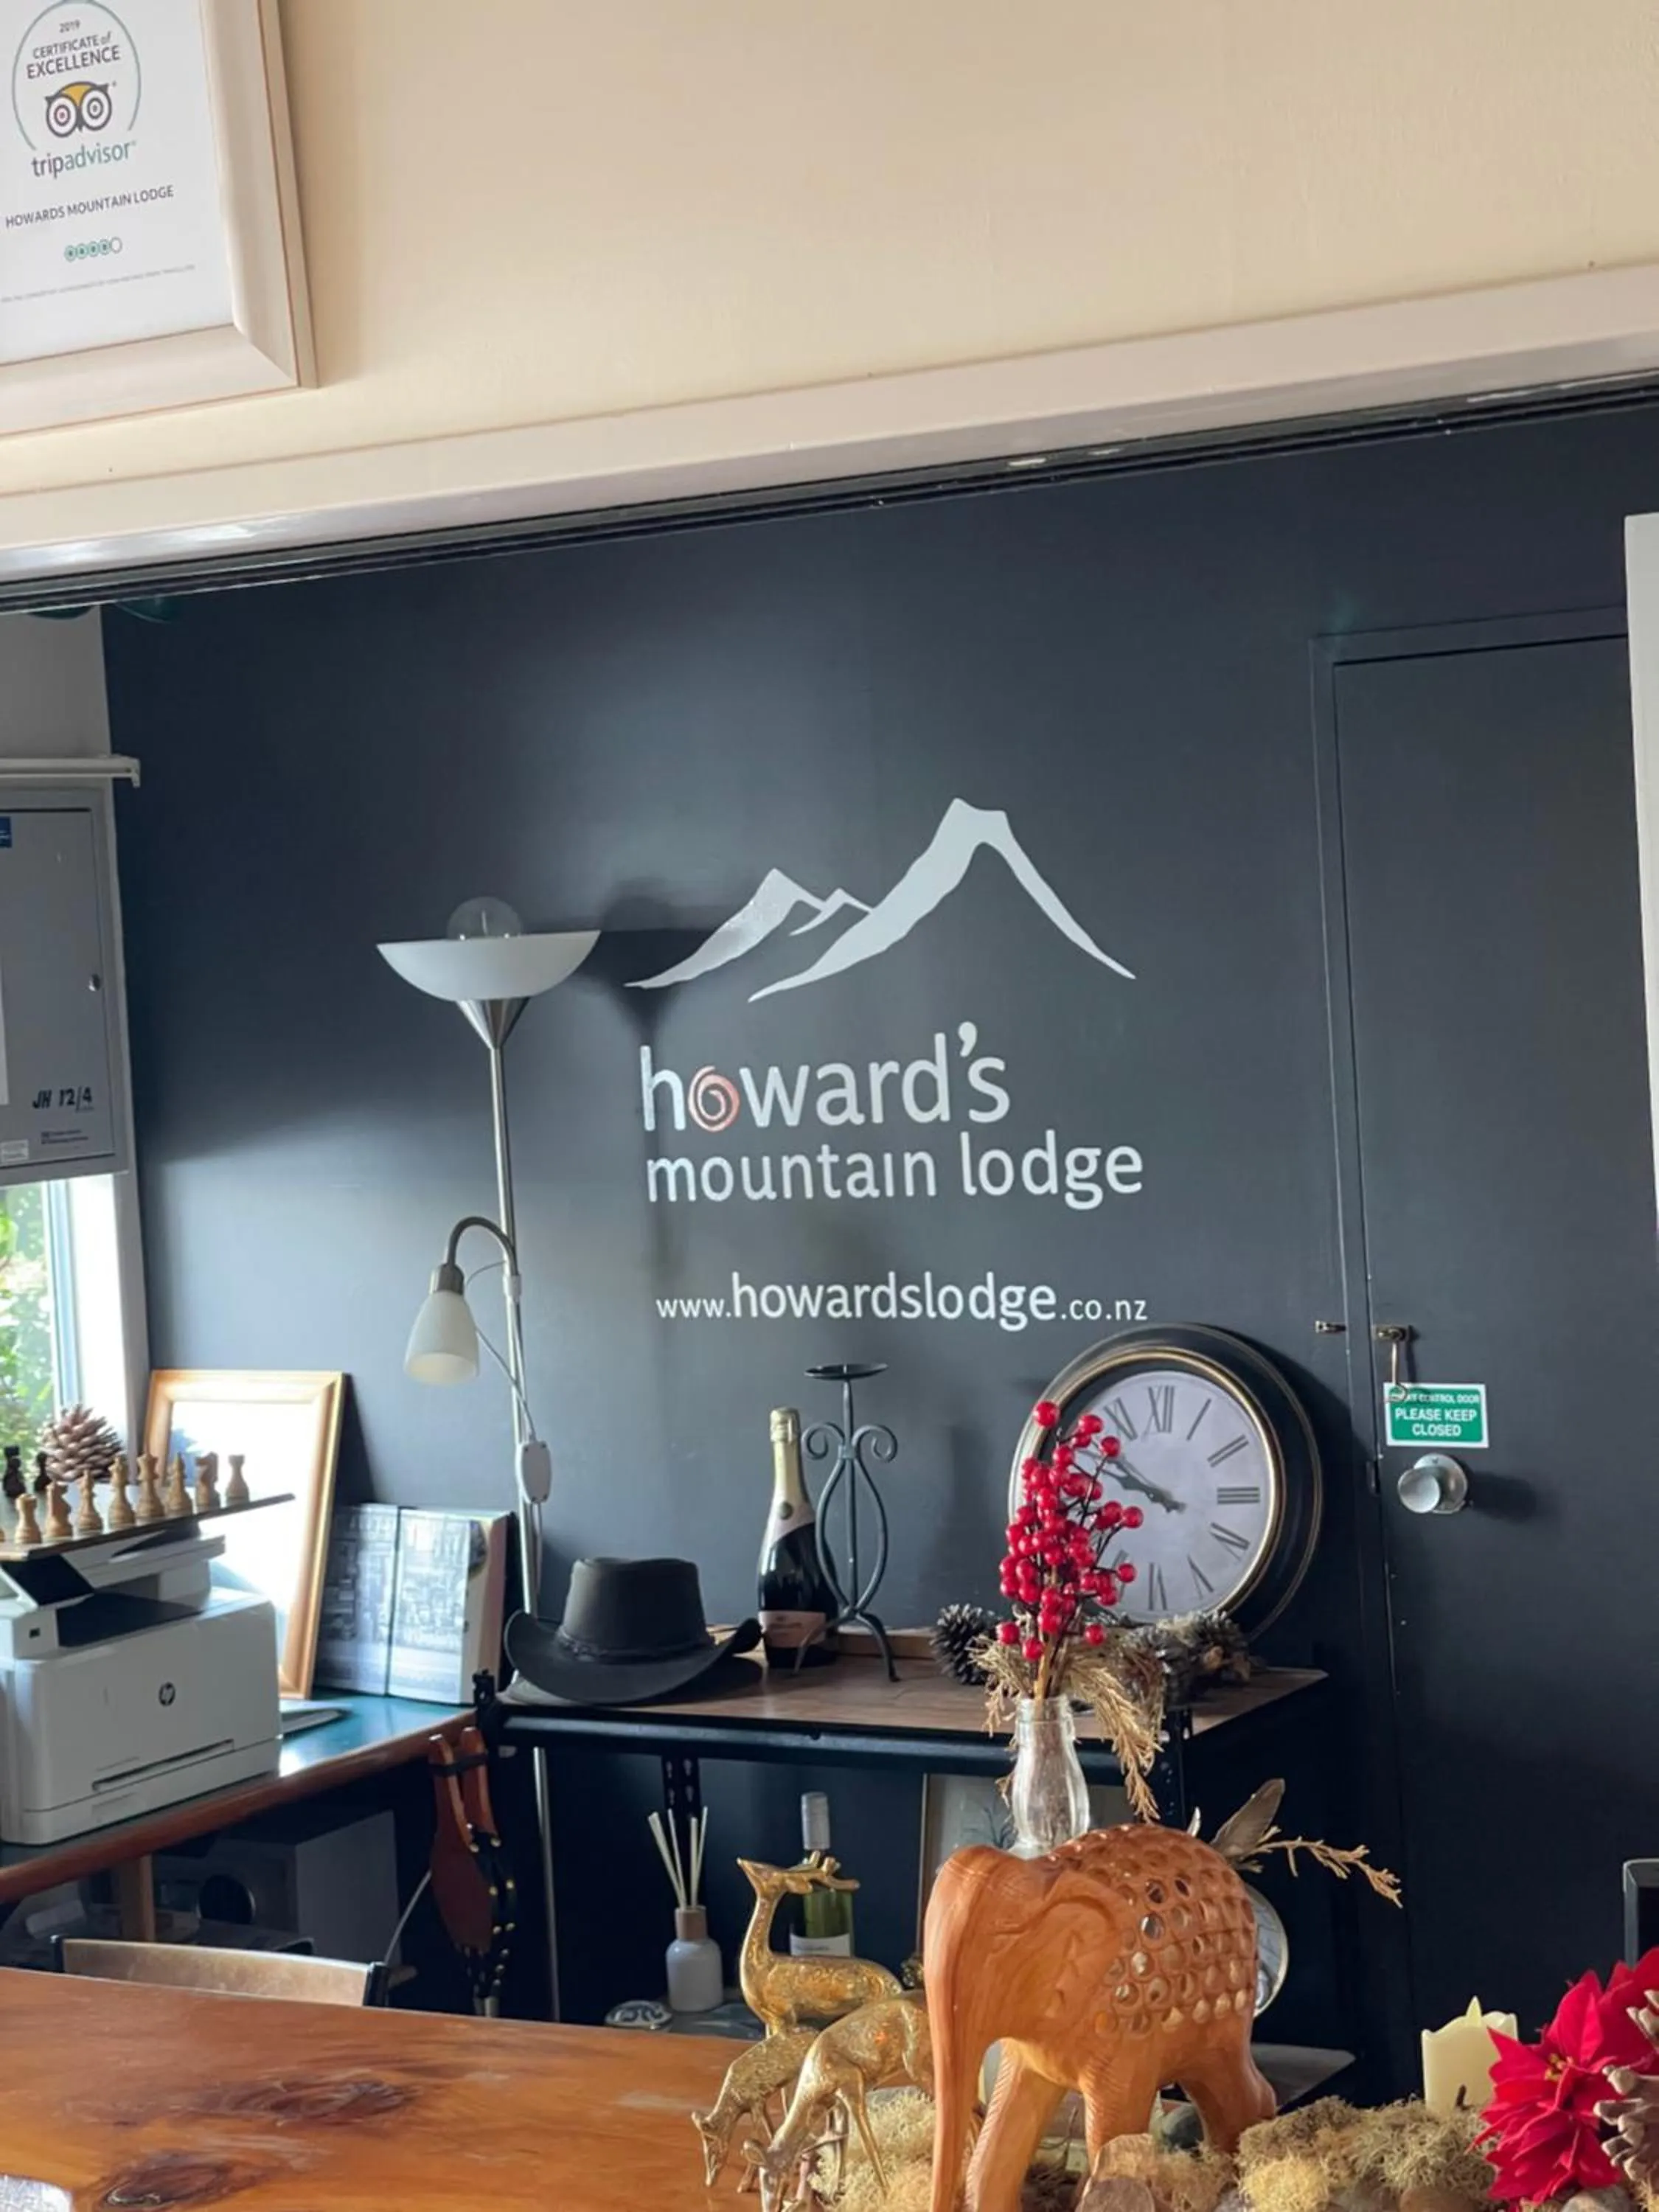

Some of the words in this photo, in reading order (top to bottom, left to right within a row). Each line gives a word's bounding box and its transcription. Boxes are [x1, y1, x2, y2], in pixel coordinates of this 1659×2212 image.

[59, 19, 80, 33] 2019
[26, 45, 121, 80] EXCELLENCE
[32, 35, 100, 60] CERTIFICATE
[100, 30, 112, 45] of
[31, 142, 131, 179] tripadvisor
[5, 205, 66, 229] HOWARDS
[66, 192, 133, 216] MOUNTAIN
[133, 184, 174, 204] LODGE
[639, 1022, 1010, 1133] howard's
[646, 1144, 936, 1202] mountain
[960, 1129, 1144, 1210] lodge
[655, 1271, 1148, 1331] www.howardslodge.co.nz
[1394, 1407, 1441, 1422] PLEASE
[1444, 1408, 1477, 1422] KEEP
[1411, 1423, 1462, 1437] CLOSED
